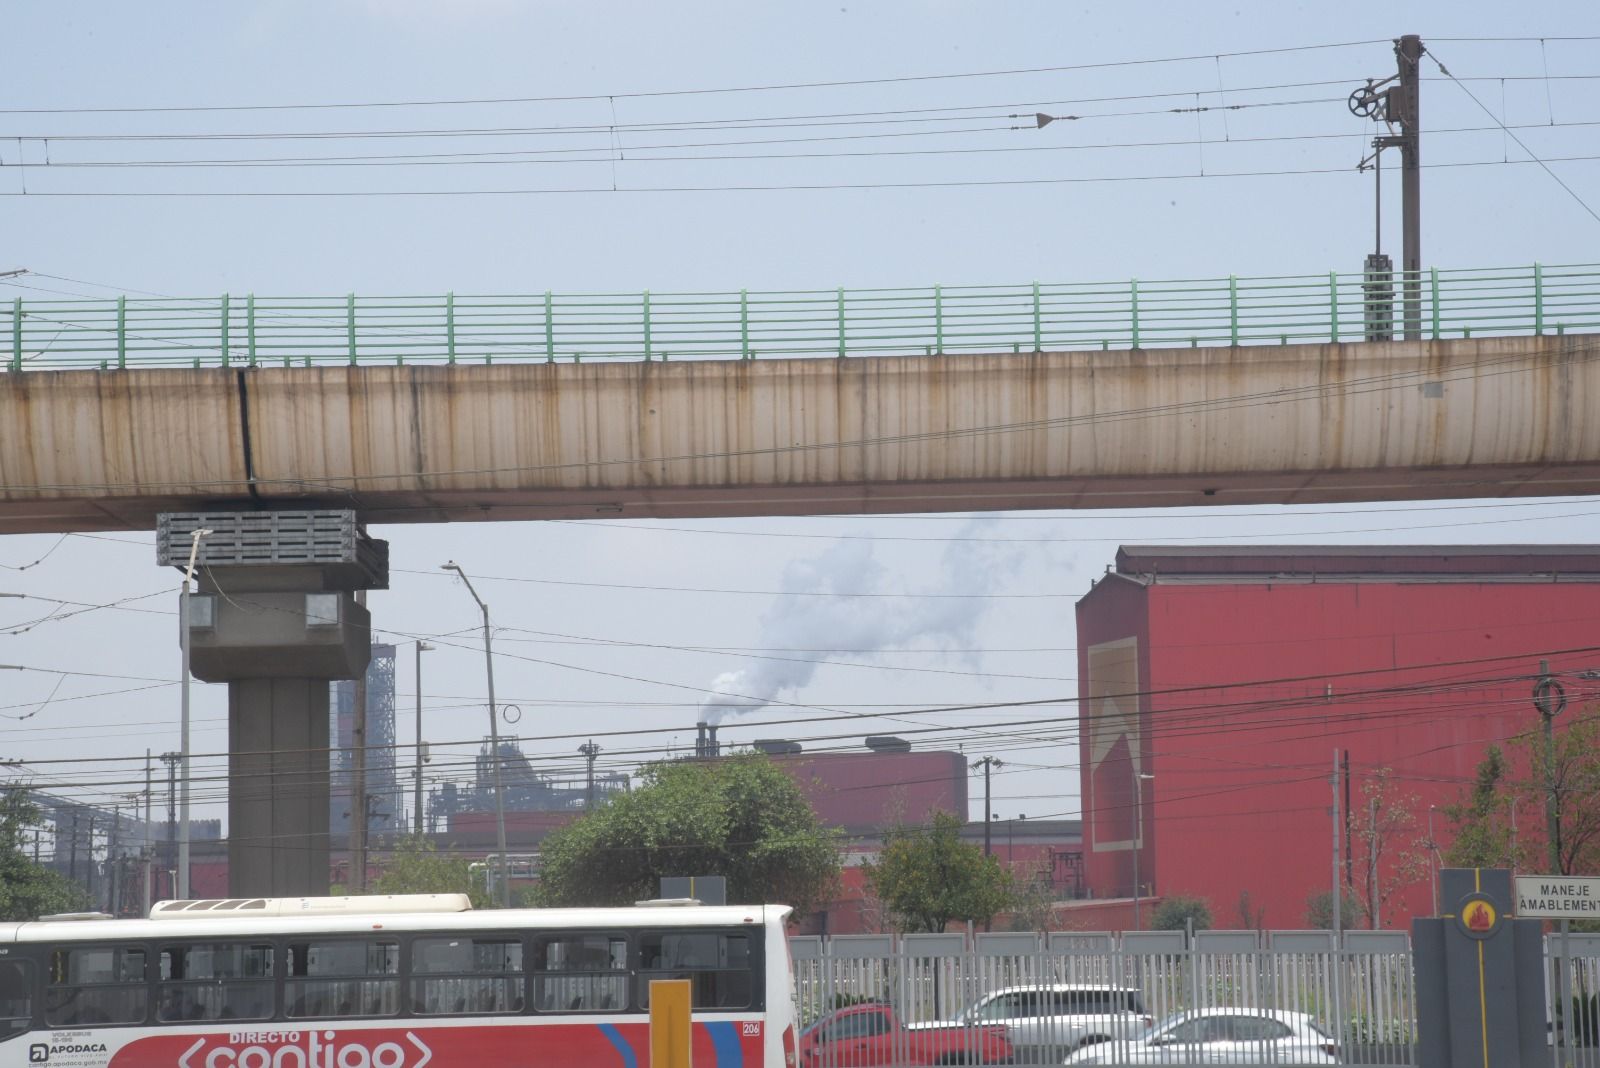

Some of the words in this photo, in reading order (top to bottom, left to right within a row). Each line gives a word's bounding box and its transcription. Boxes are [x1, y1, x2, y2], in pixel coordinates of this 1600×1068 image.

[1540, 885, 1590, 896] MANEJE
[744, 1023, 759, 1034] 206
[229, 1031, 300, 1044] DIRECTO
[50, 1044, 107, 1054] APODACA
